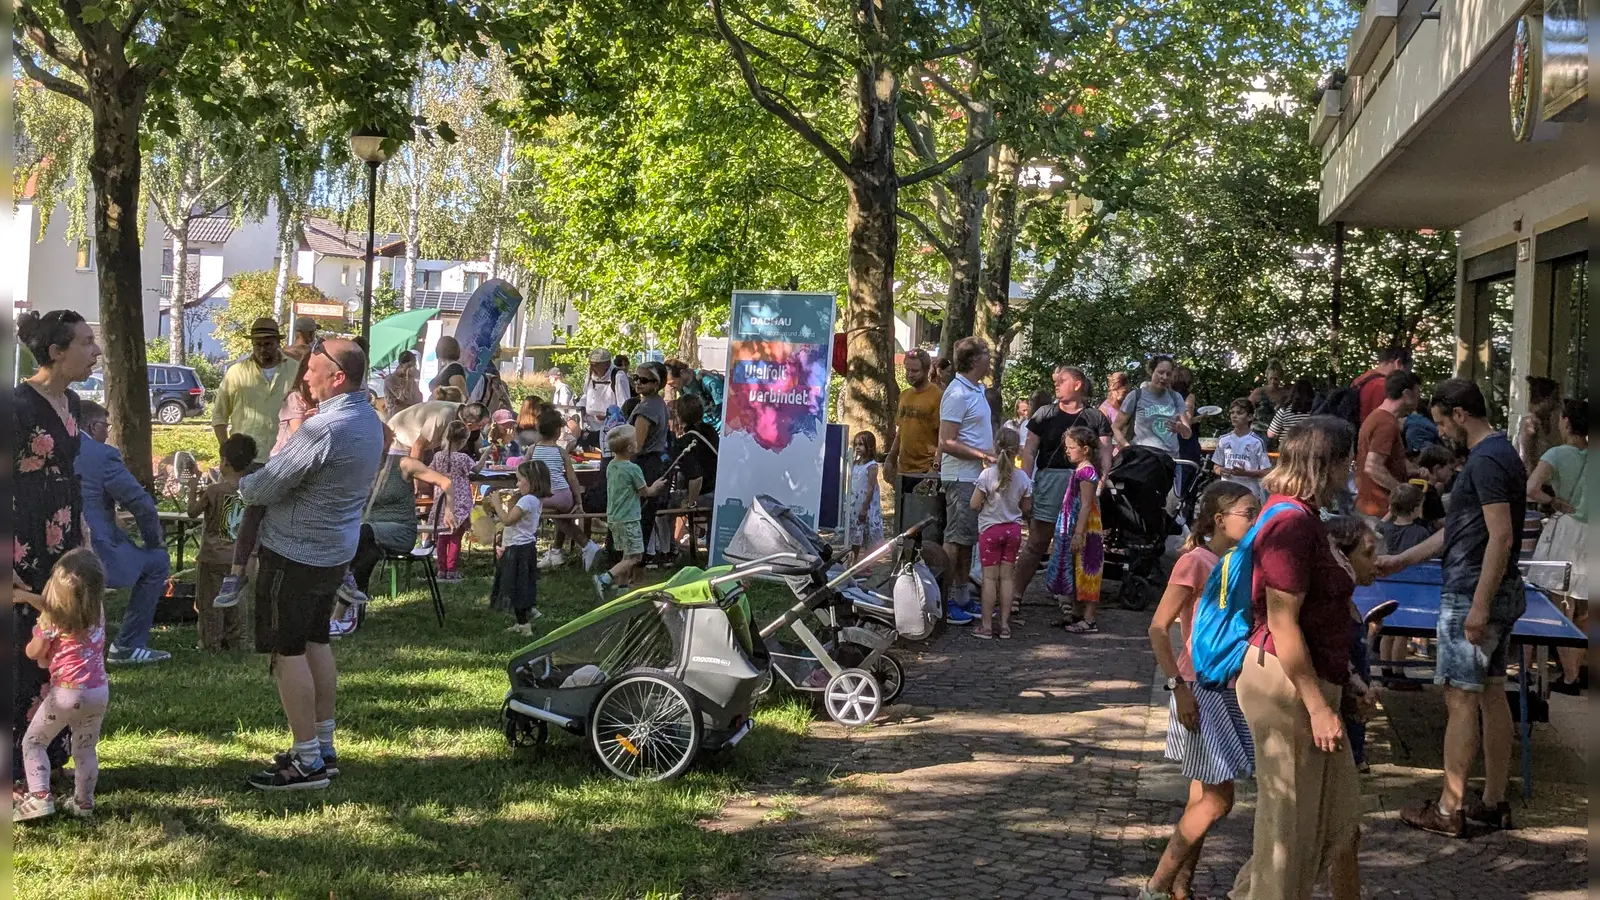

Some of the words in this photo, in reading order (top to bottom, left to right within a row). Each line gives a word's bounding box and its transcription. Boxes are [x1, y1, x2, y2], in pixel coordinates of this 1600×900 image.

[750, 316, 792, 326] DACHAU
[744, 364, 787, 381] Vielfalt
[749, 387, 809, 406] verbindet
